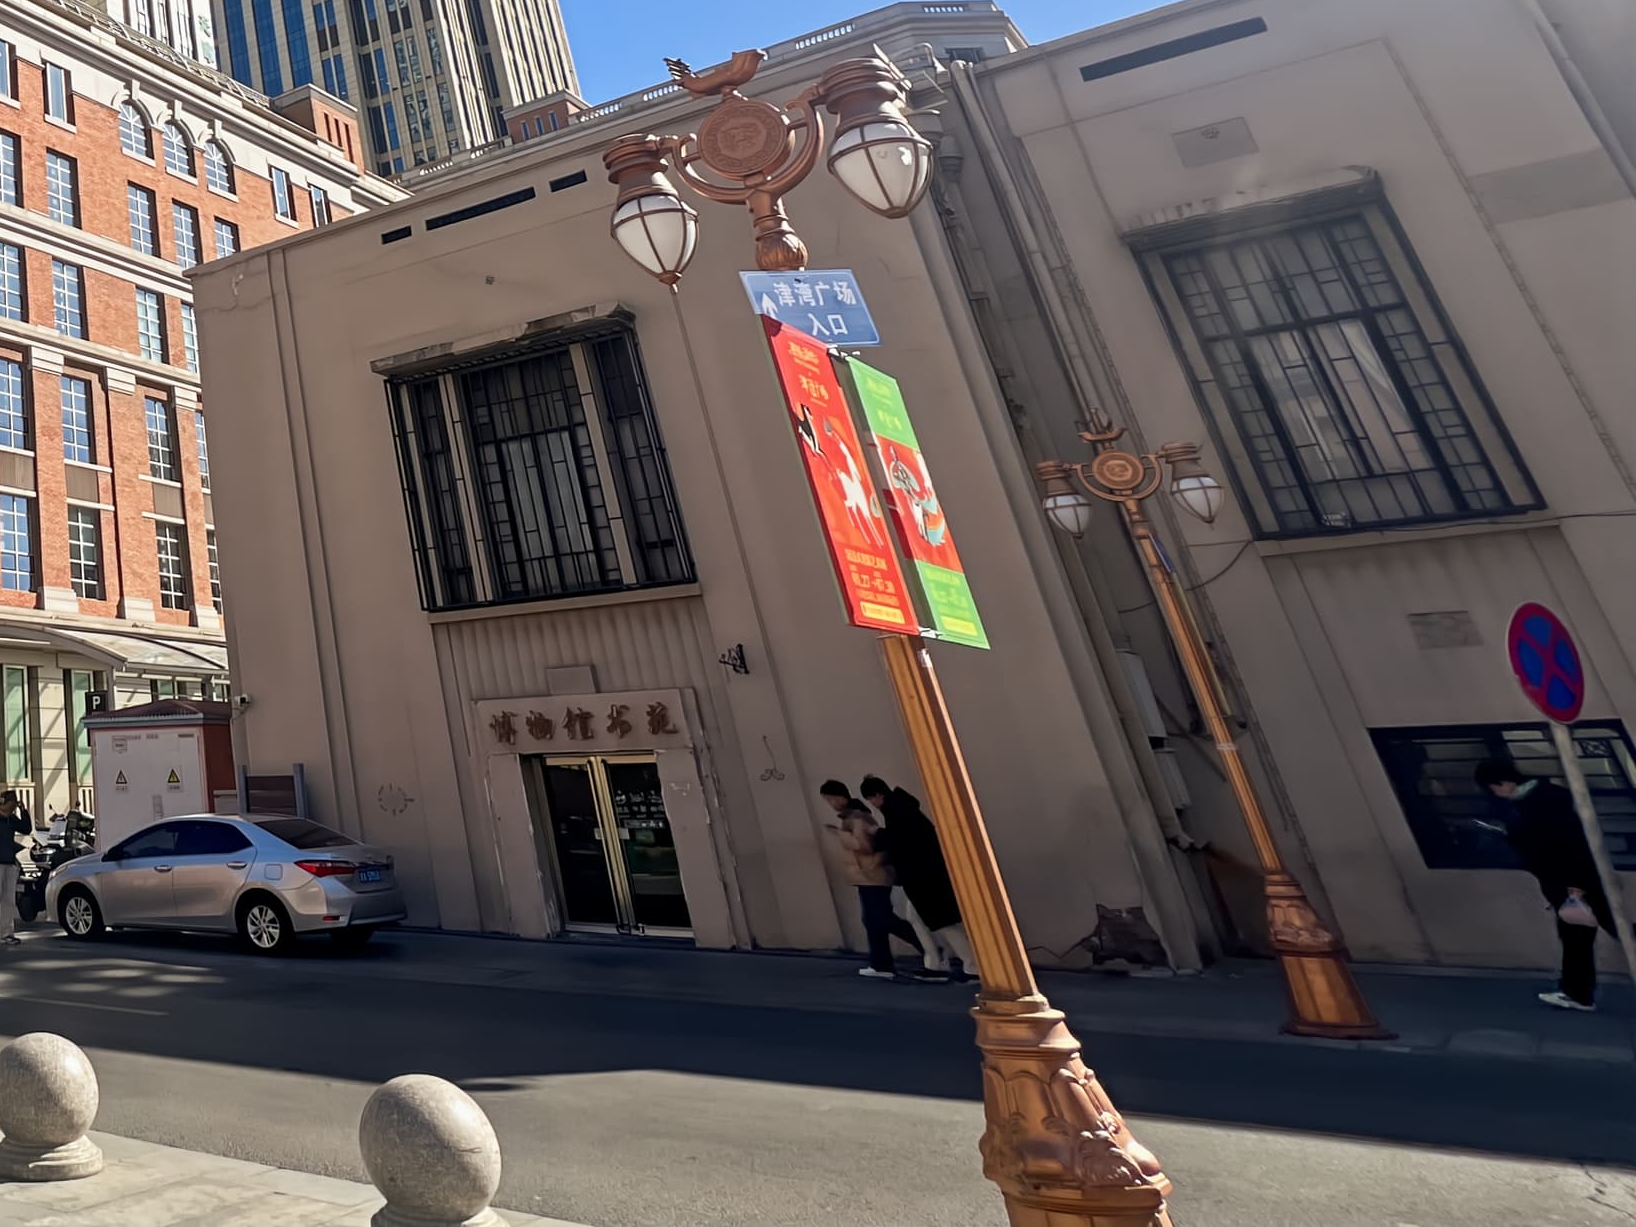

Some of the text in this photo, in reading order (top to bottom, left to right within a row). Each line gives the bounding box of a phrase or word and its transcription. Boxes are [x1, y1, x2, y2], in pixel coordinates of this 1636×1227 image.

[773, 281, 857, 307] 津湾广场
[807, 313, 848, 336] 入口
[92, 696, 101, 710] P
